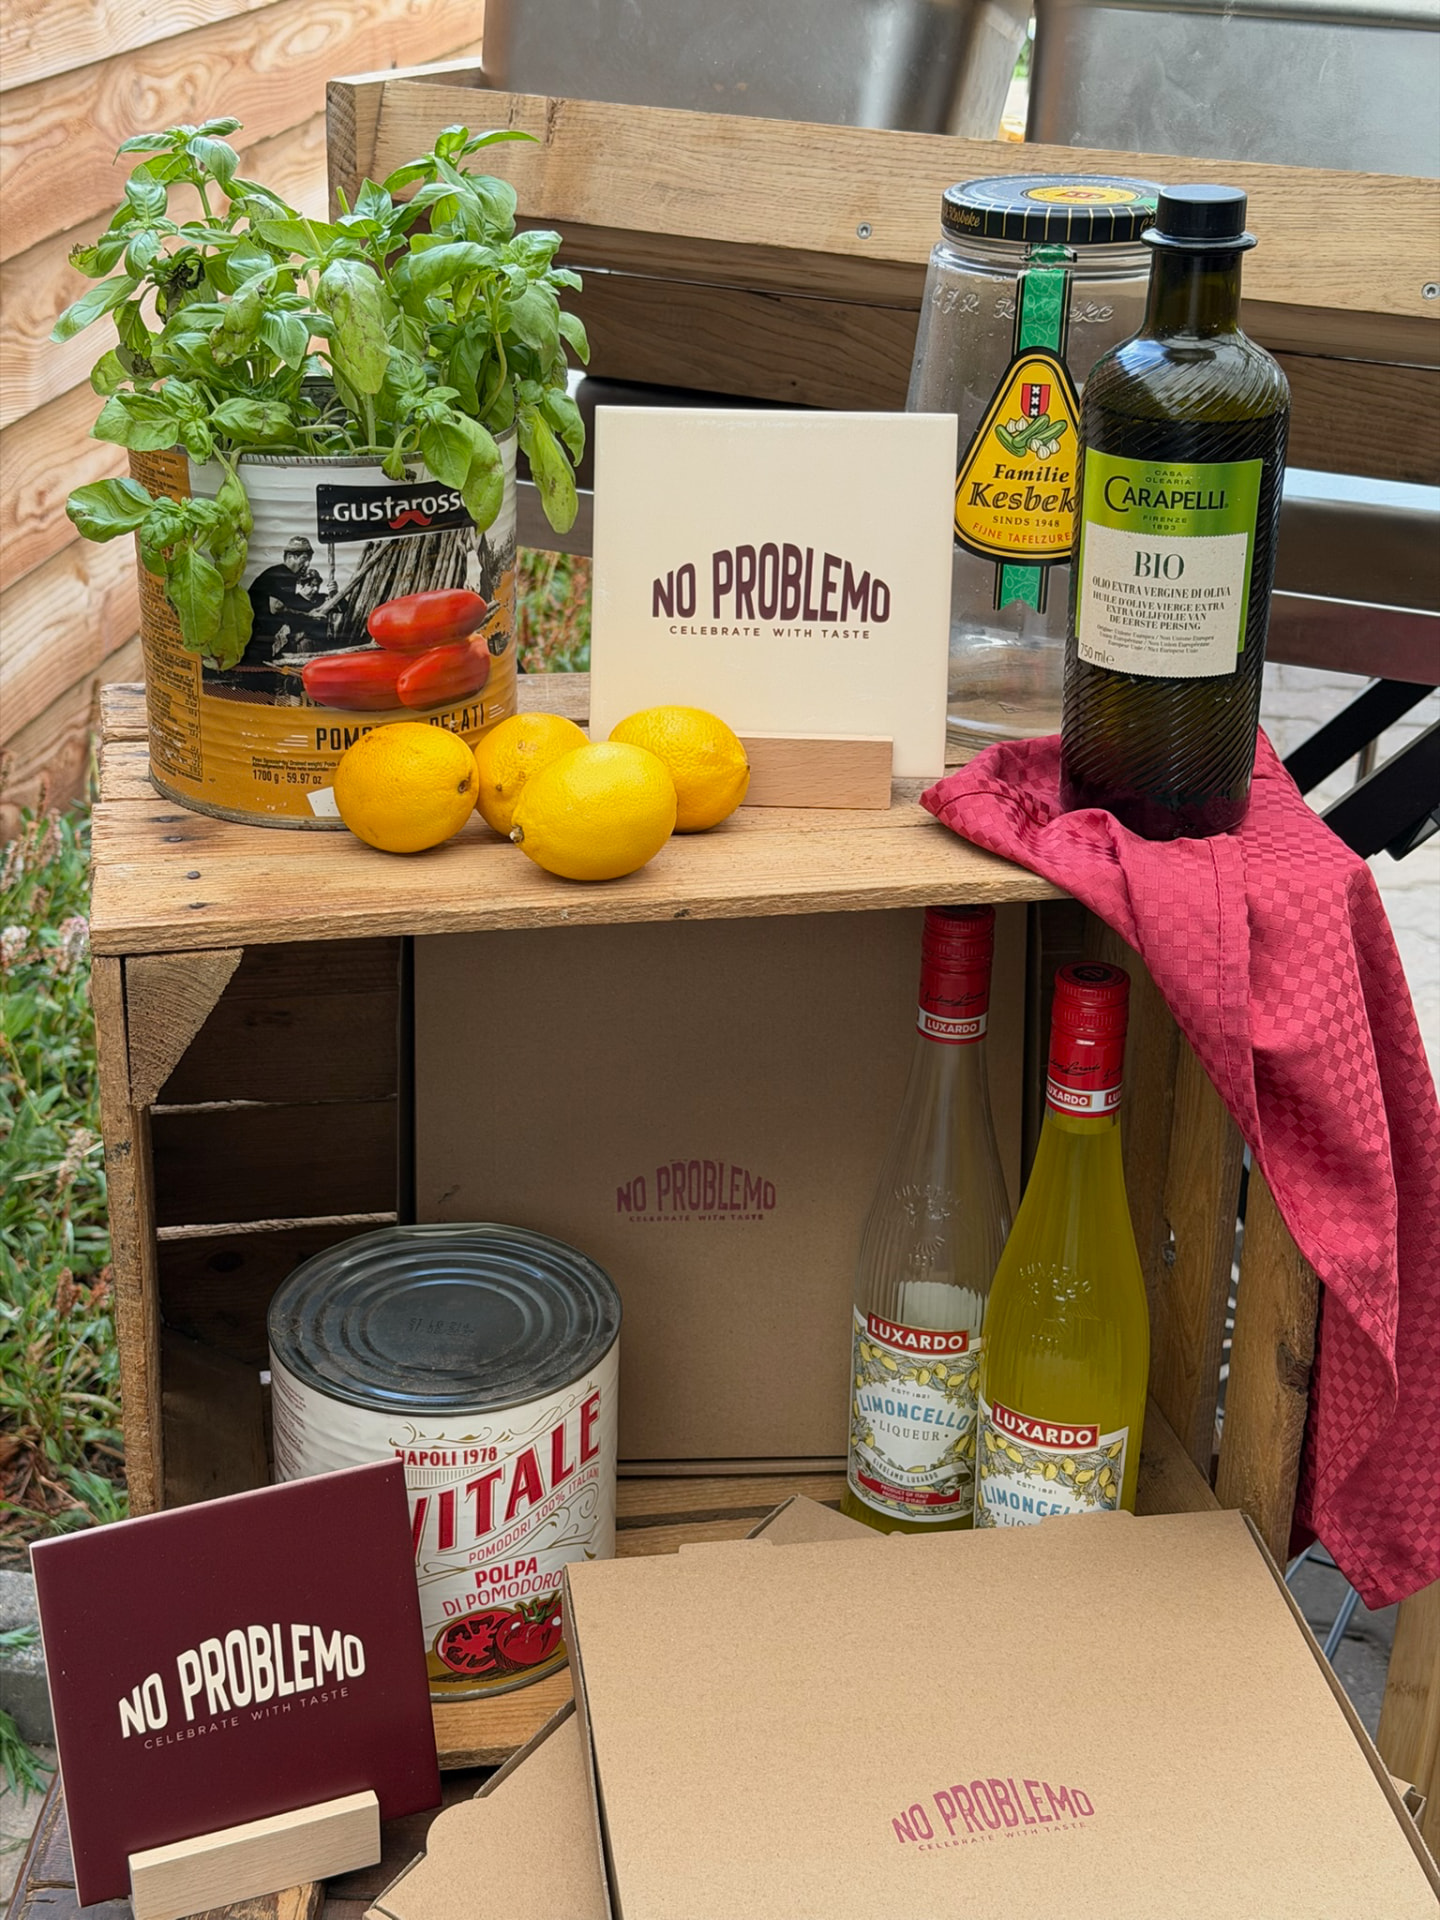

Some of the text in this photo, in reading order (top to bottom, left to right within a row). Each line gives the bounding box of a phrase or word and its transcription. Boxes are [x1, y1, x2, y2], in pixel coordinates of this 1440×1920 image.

[993, 463, 1070, 483] Familie
[1145, 476, 1191, 485] OLEARIA
[1154, 469, 1183, 477] CASA
[967, 482, 1076, 513] Kesbek
[1104, 475, 1225, 512] CARAPELLI
[333, 491, 466, 522] Gustaross
[993, 515, 1060, 528] SINDS 1948
[1143, 515, 1187, 524] FIRENZE
[1152, 523, 1176, 531] 1893
[972, 522, 1072, 544] FIJNE TAFELZURE
[1133, 550, 1185, 581] BIO
[652, 542, 890, 623] NO PROBLEMO
[1092, 576, 1231, 599] OLIO EXTRA VERGINE DI OLIVA
[1092, 590, 1225, 612] HUILE D'OLIVE VIERGE EXTRA
[1106, 604, 1134, 617] EXTRA
[1187, 613, 1207, 621] VAN
[669, 625, 870, 639] CELEBRATE WITH TASTE
[1109, 614, 1201, 631] DE EERSTE PERSING
[1080, 642, 1093, 659] 750
[253, 769, 272, 781] 1700
[274, 773, 279, 784] g
[287, 772, 310, 784] 59.97
[312, 776, 322, 784] oz
[927, 1019, 977, 1033] LUXARDO
[616, 1160, 776, 1213] NO PROBLEMO
[629, 1214, 690, 1222] CELEBRATE
[731, 1213, 764, 1221] TASTE
[870, 1320, 964, 1351] LUXARDO
[859, 1394, 970, 1431] LIMONCELLO
[879, 1420, 940, 1441] LIQUEUR
[995, 1407, 1092, 1446] LUXARDO
[395, 1446, 498, 1466] NAPOLI 1978
[984, 1485, 1083, 1516] LIMONCE
[468, 1519, 531, 1564] POMODORI
[535, 1491, 565, 1524] 100%
[475, 1556, 537, 1589] POLPA
[442, 1570, 563, 1617] DI POMODORO
[118, 1623, 366, 1739] NO PROBLEMO
[144, 1687, 349, 1750] CELEBRATE WITH TASTE
[891, 1778, 1095, 1843] NO PROBLEMO
[918, 1822, 1086, 1851] CELEBRATE WITH TASTE
